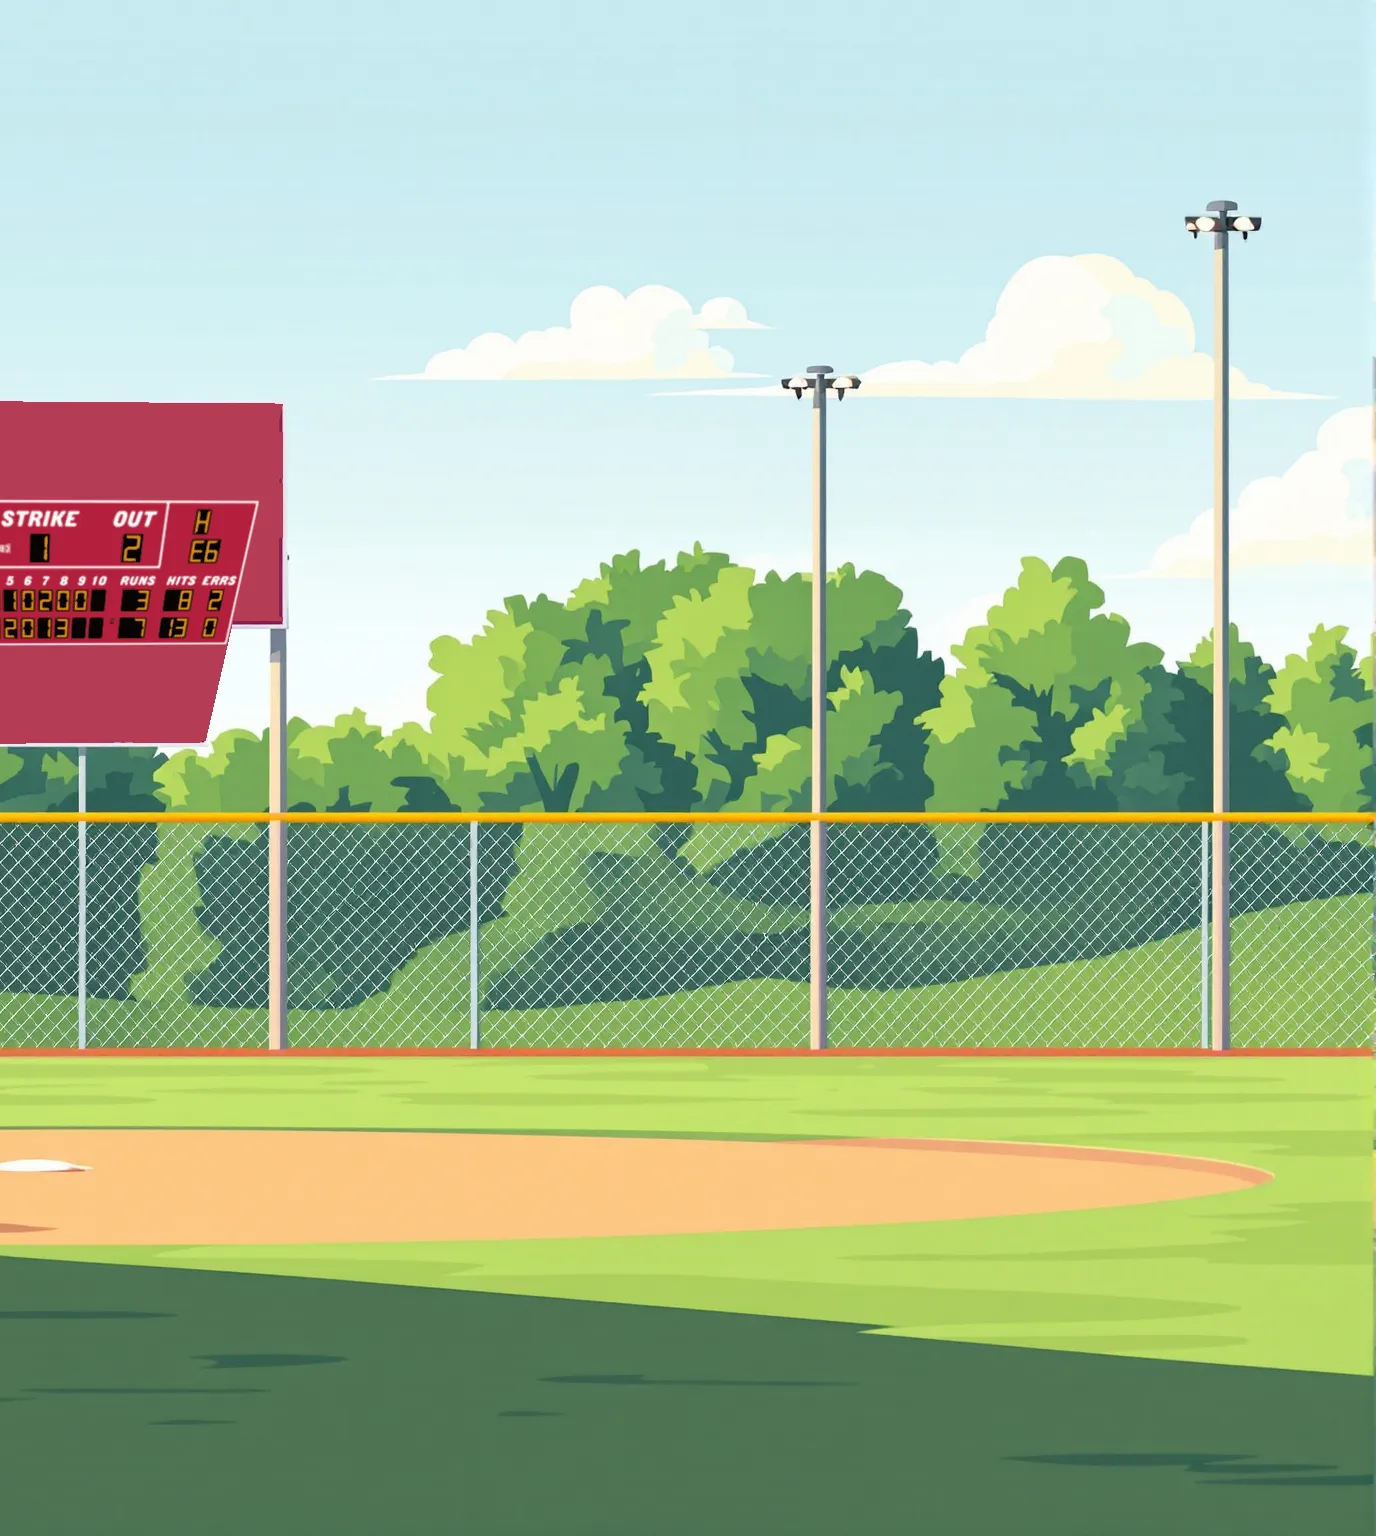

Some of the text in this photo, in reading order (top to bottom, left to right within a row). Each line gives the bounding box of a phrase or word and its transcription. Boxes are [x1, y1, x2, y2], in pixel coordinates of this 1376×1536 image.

[1, 510, 80, 527] STRIKE
[113, 511, 157, 527] OUT
[194, 510, 211, 534] H
[123, 535, 142, 562] 2
[189, 540, 219, 563] E6
[5, 576, 15, 586] 5
[23, 576, 33, 586] 6
[42, 576, 50, 586] 7
[59, 576, 69, 586] 8
[77, 576, 87, 586] 9
[92, 576, 108, 586] 10
[120, 576, 156, 586] RUNS
[166, 576, 197, 586] HITS
[202, 576, 237, 586] ERRS
[22, 590, 35, 611] 0
[39, 590, 53, 611] 2
[57, 590, 70, 611] 0
[74, 590, 88, 611] 0
[136, 590, 150, 611] 3
[177, 590, 193, 611] 8
[207, 590, 224, 611] 2
[4, 618, 17, 638] 2
[21, 618, 34, 638] 0
[56, 618, 69, 638] 3
[134, 618, 146, 638] 7
[168, 618, 188, 638] 13
[202, 618, 218, 638] 0
